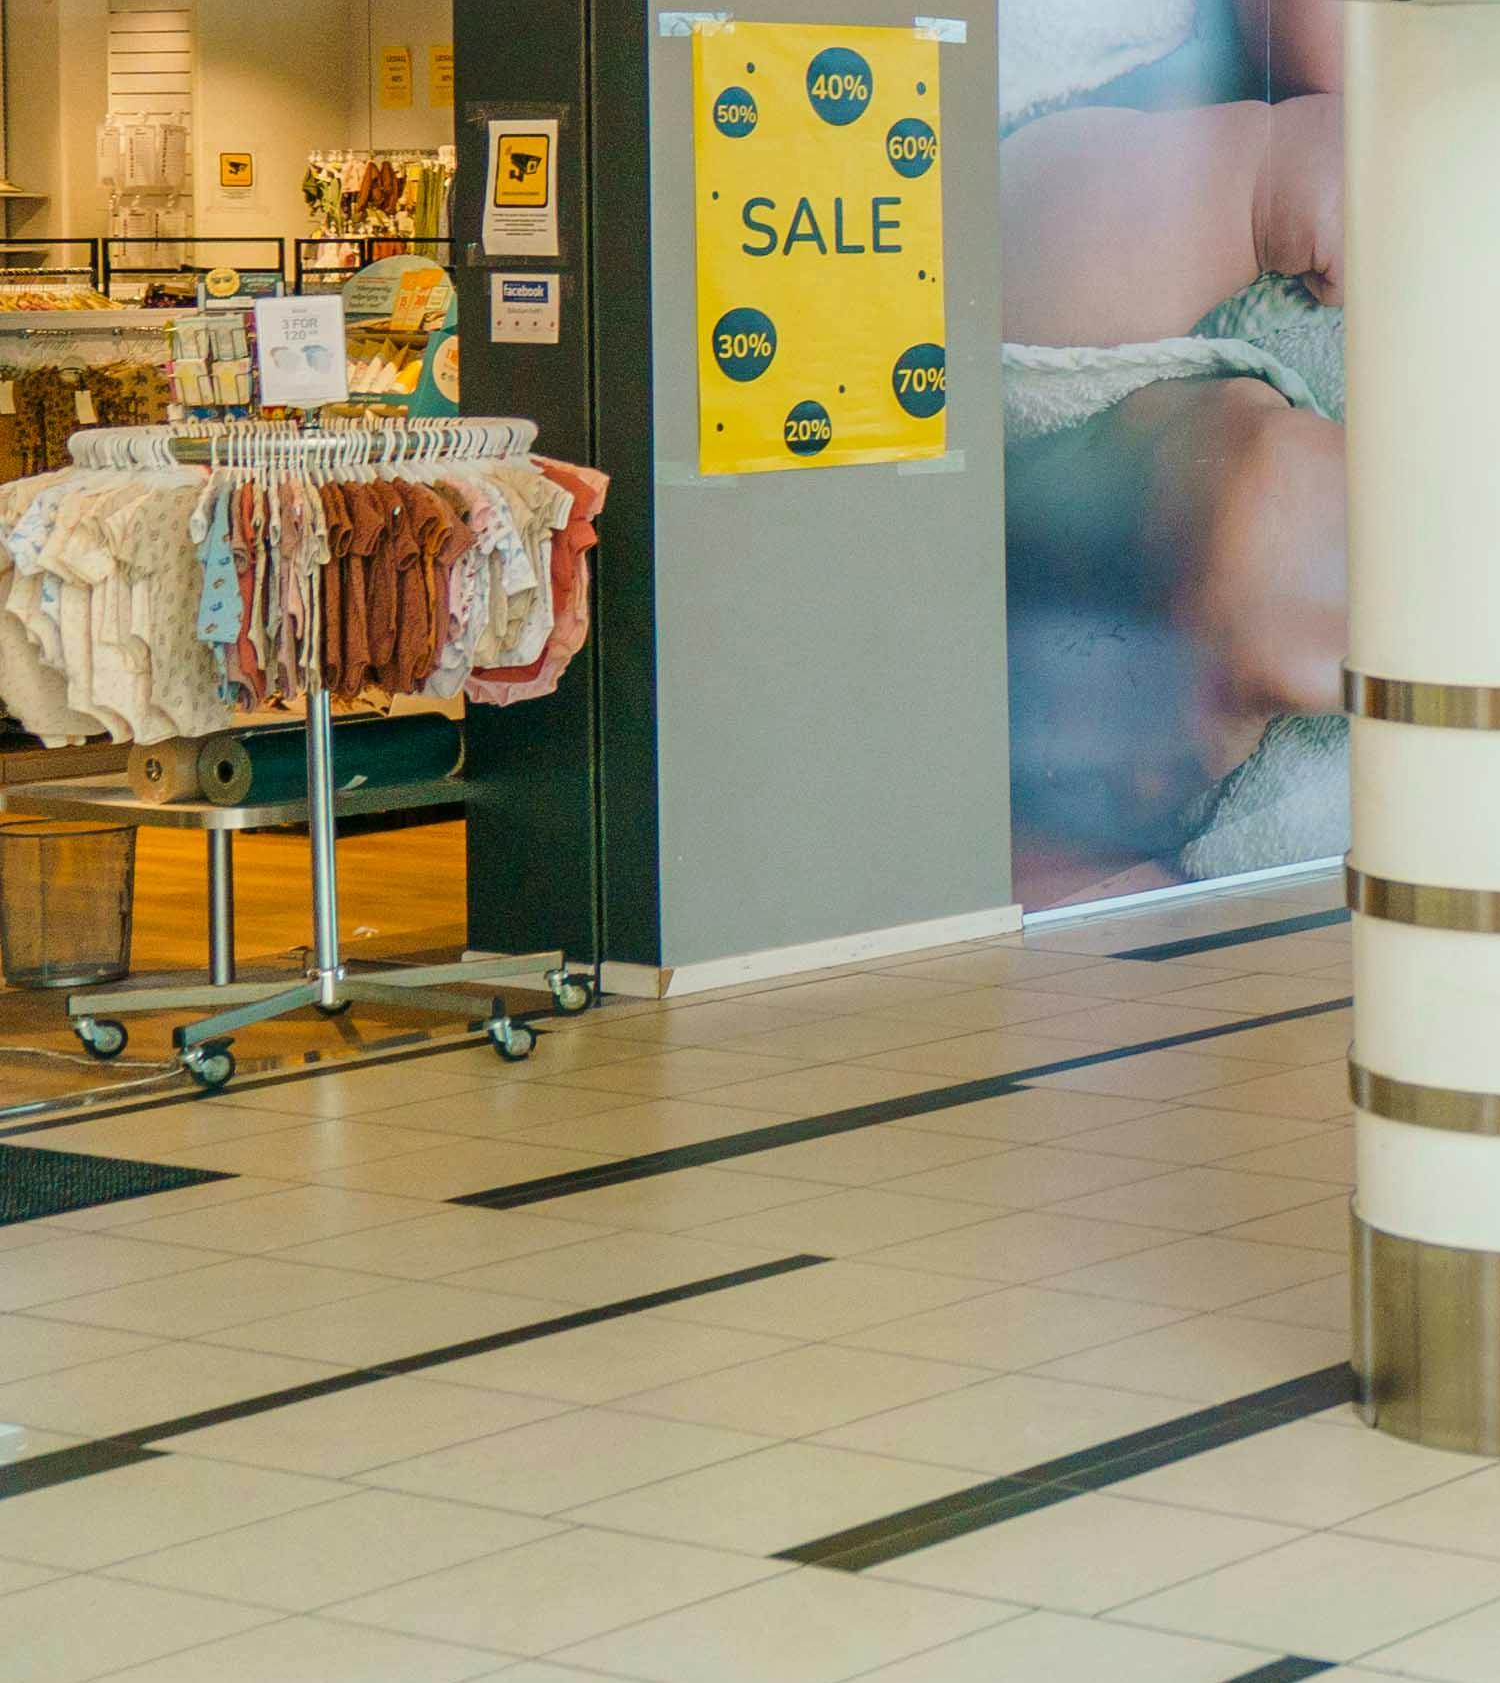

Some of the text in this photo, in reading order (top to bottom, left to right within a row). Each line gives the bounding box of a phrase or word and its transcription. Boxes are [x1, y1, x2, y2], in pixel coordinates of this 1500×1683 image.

[811, 74, 868, 102] 40%
[717, 104, 757, 124] 50%
[889, 136, 937, 160] 60%
[741, 196, 903, 257] SALE
[717, 333, 773, 359] 30%
[898, 367, 946, 393] 70%
[785, 419, 831, 442] 20%
